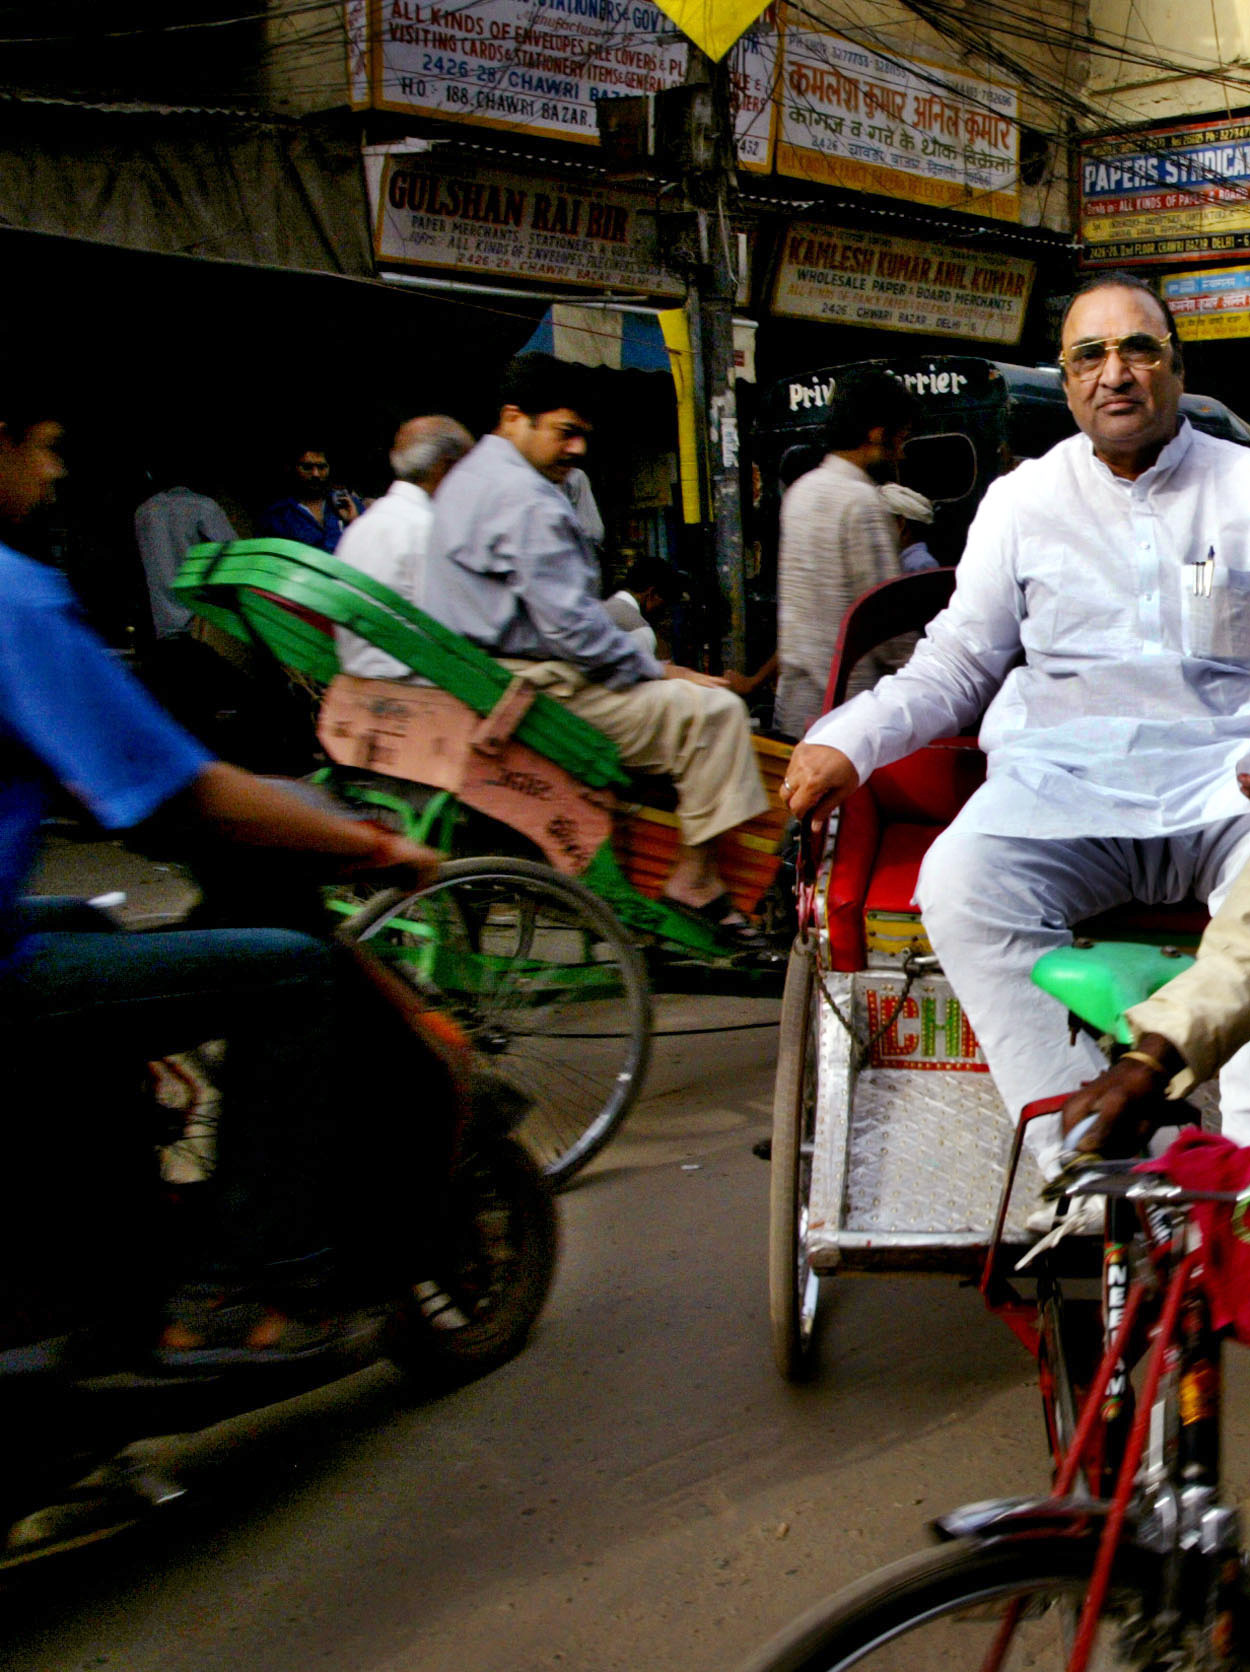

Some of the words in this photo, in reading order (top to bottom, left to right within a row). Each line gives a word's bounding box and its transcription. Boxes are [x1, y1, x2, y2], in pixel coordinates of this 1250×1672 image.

[389, 22, 457, 52] VISITING
[391, 0, 425, 23] ALL
[431, 7, 484, 36] KINDS
[490, 21, 510, 40] OF
[515, 26, 584, 56] ENVELOPES
[615, 48, 658, 73] COVERS
[508, 71, 579, 98] CHAWRI
[476, 90, 534, 116] CHAWRI
[788, 60, 860, 114] कमलेश
[863, 81, 908, 119] कुमार
[913, 95, 961, 137] अनिल
[965, 108, 1013, 150] कुमार
[900, 129, 916, 151] के
[1084, 155, 1159, 194] PAPERS
[389, 169, 529, 228] GULSHAN
[532, 191, 580, 235] RAI
[1119, 199, 1134, 213] ALL
[1136, 196, 1162, 211] KINDS
[1165, 195, 1178, 208] OF
[411, 215, 446, 233] PAPER
[452, 222, 519, 242] MERCHANTS
[1211, 235, 1235, 249] DELHI
[789, 235, 875, 276] KAMLESH
[876, 250, 932, 284] KUMAR
[933, 260, 968, 290] ANIL
[970, 266, 1025, 298] KUMAR
[797, 268, 867, 291] WHOLESALE
[872, 279, 906, 296] PAPER
[915, 286, 953, 303] BOARD
[954, 292, 1014, 312] MERCHANTS
[788, 376, 837, 412] Priv
[893, 363, 968, 396] rrier
